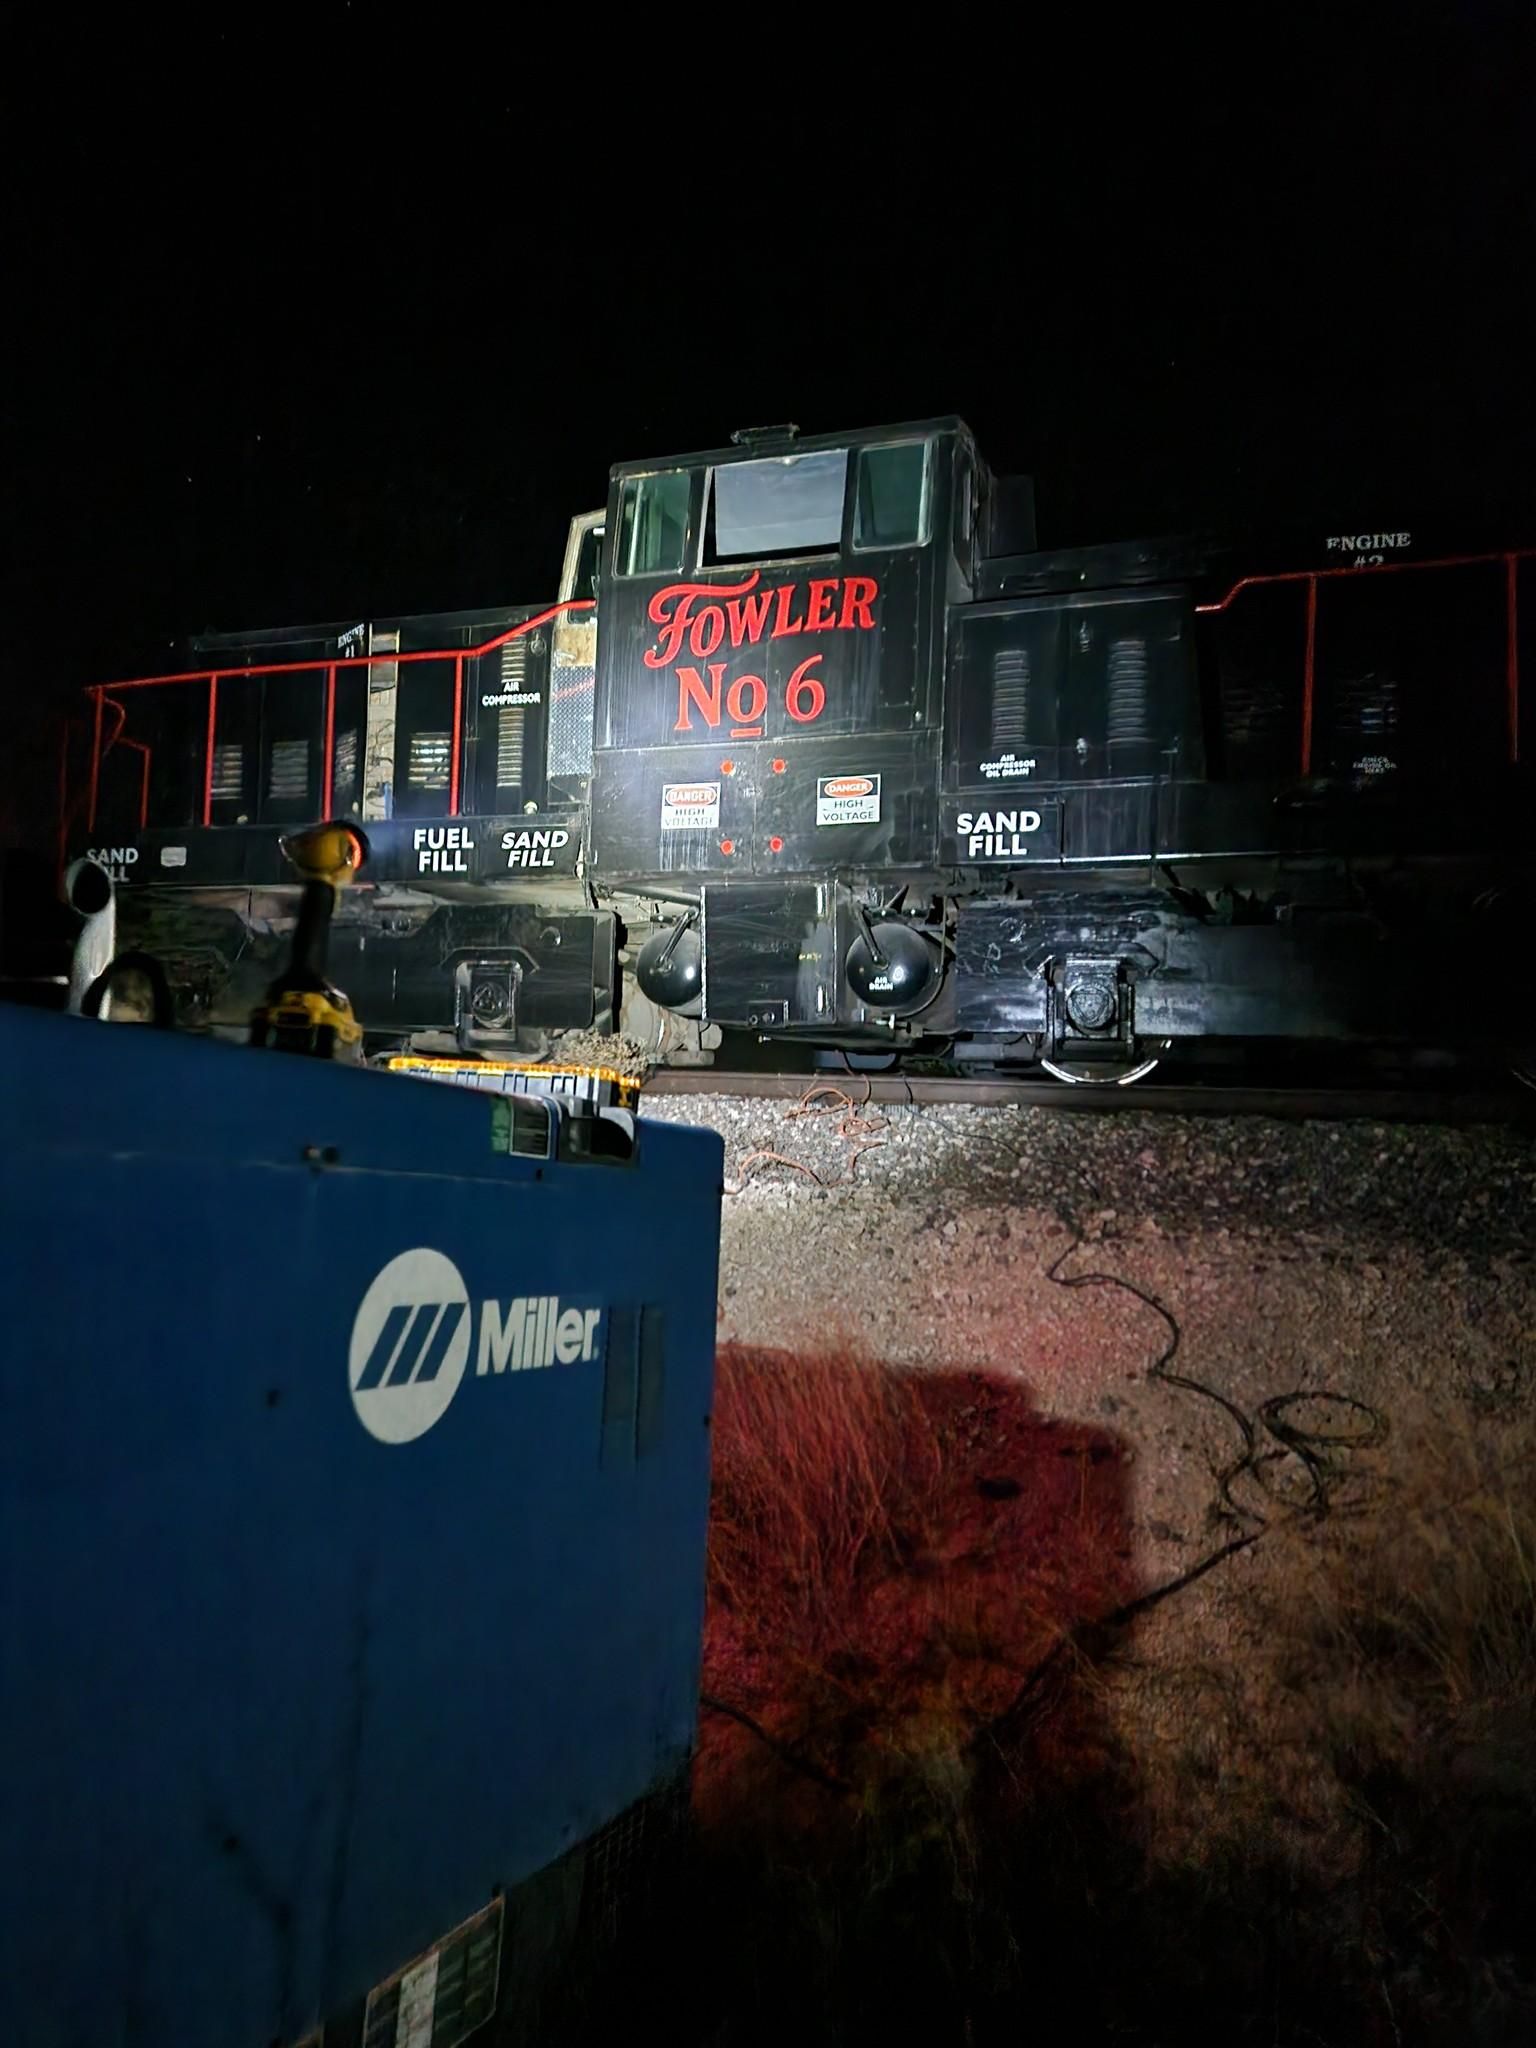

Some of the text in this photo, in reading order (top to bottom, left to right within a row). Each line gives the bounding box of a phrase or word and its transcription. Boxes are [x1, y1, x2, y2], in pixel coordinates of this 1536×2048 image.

[1326, 532, 1411, 551] ENGINE
[644, 568, 878, 669] FOWLER
[503, 681, 520, 692] AIR
[785, 654, 826, 723] 6
[481, 692, 541, 707] COMPRESSOR
[979, 759, 1036, 772] COMPRESSOR
[999, 753, 1016, 762] AIR
[669, 790, 713, 802] DANGER
[829, 782, 868, 793] DANGER
[675, 807, 705, 816] HIGH
[834, 799, 864, 809] HIGH
[664, 816, 714, 827] VOLTAGE
[823, 811, 875, 822] VOLTAGE
[956, 810, 1041, 835] SAND
[413, 827, 475, 850] FUEL
[501, 830, 569, 850] SAND
[968, 833, 1028, 857] FILL
[86, 847, 139, 864] SAND
[418, 849, 468, 872] FILL
[507, 848, 556, 868] FILL
[475, 1295, 601, 1377] Miller
